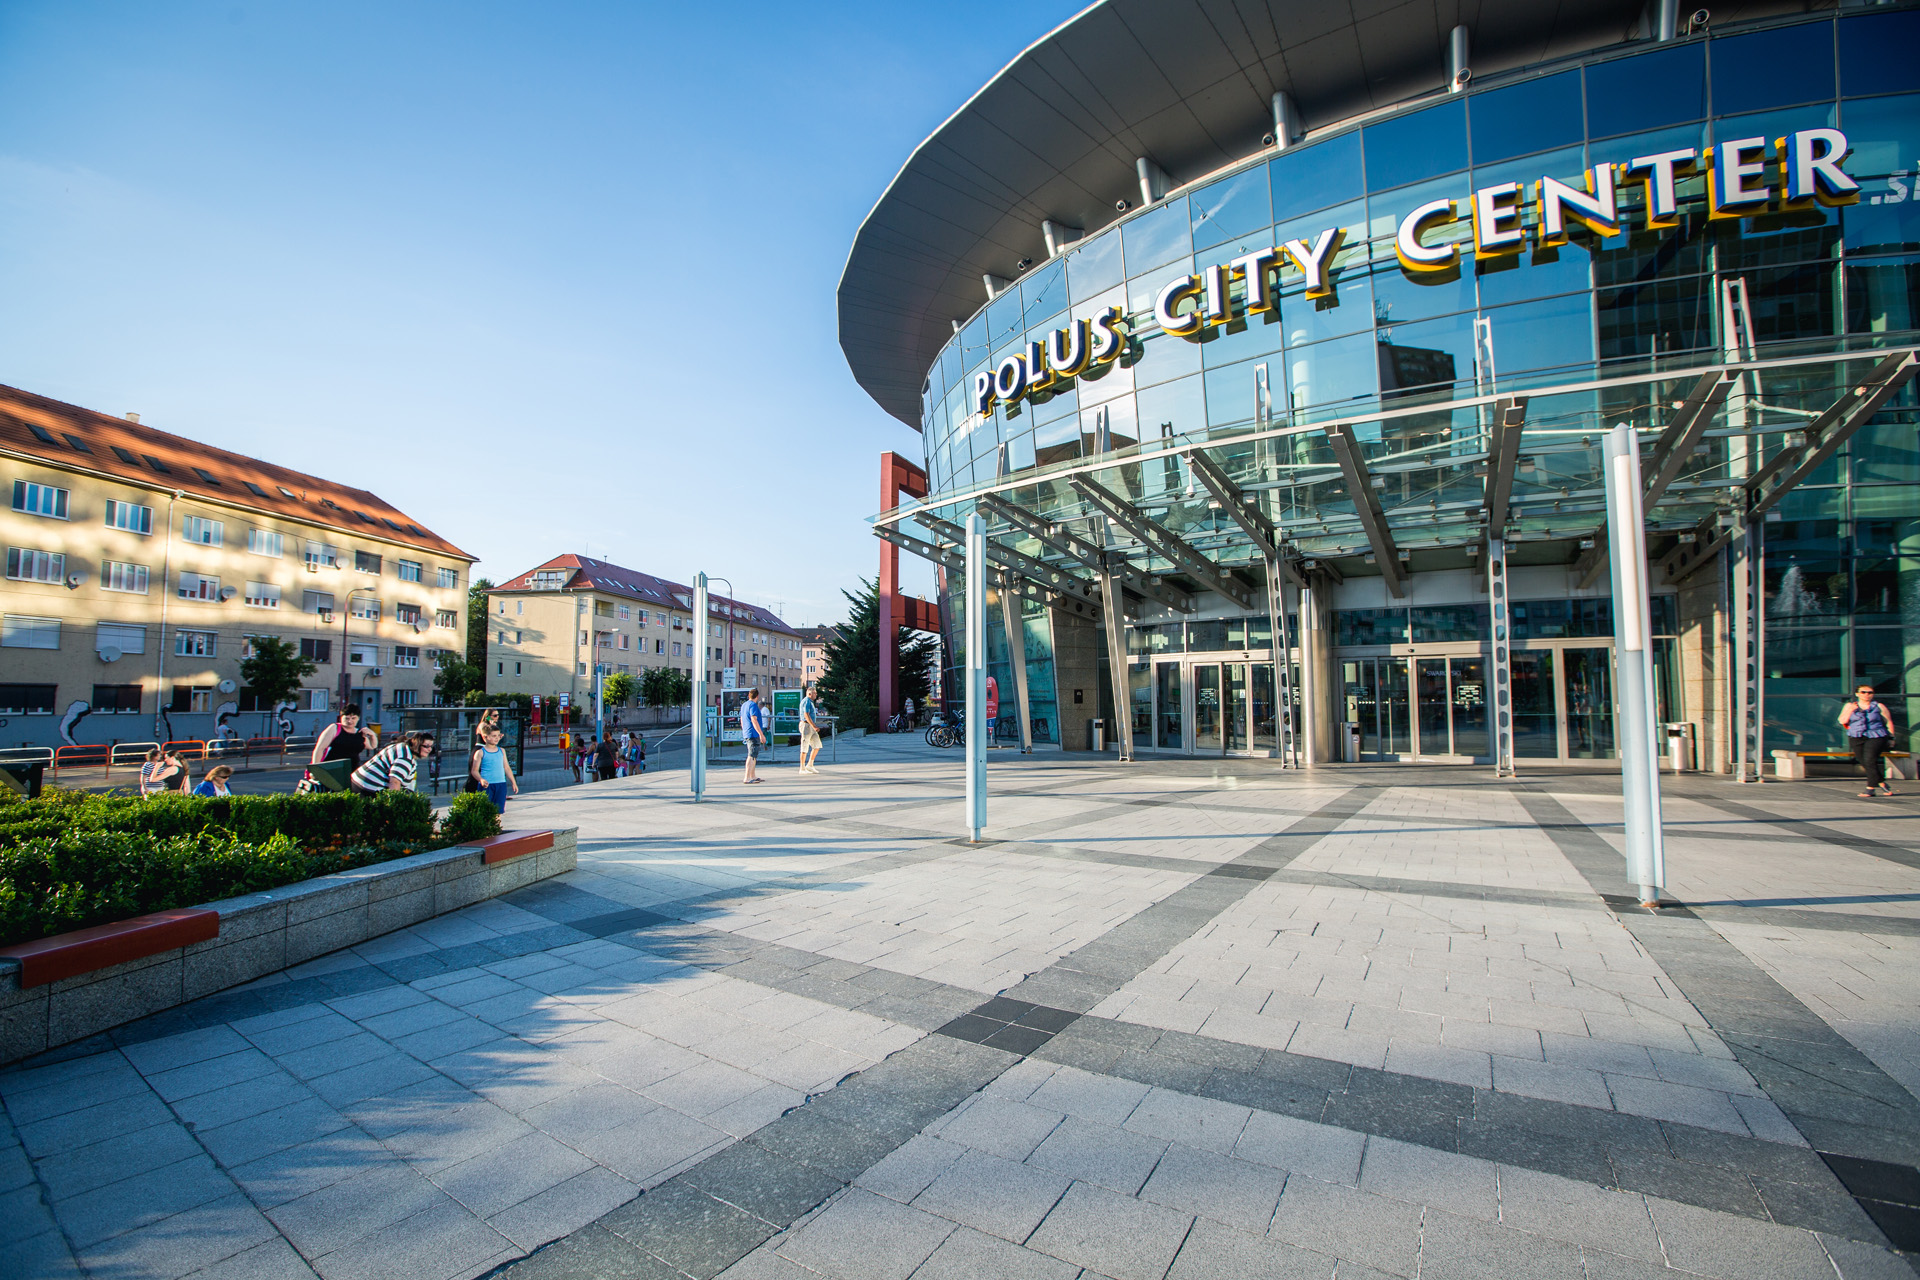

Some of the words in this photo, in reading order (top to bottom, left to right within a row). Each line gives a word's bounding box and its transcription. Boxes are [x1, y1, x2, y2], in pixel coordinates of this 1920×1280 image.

[974, 306, 1125, 415] POLUS
[1153, 226, 1346, 336] CITY
[1395, 127, 1861, 270] CENTER
